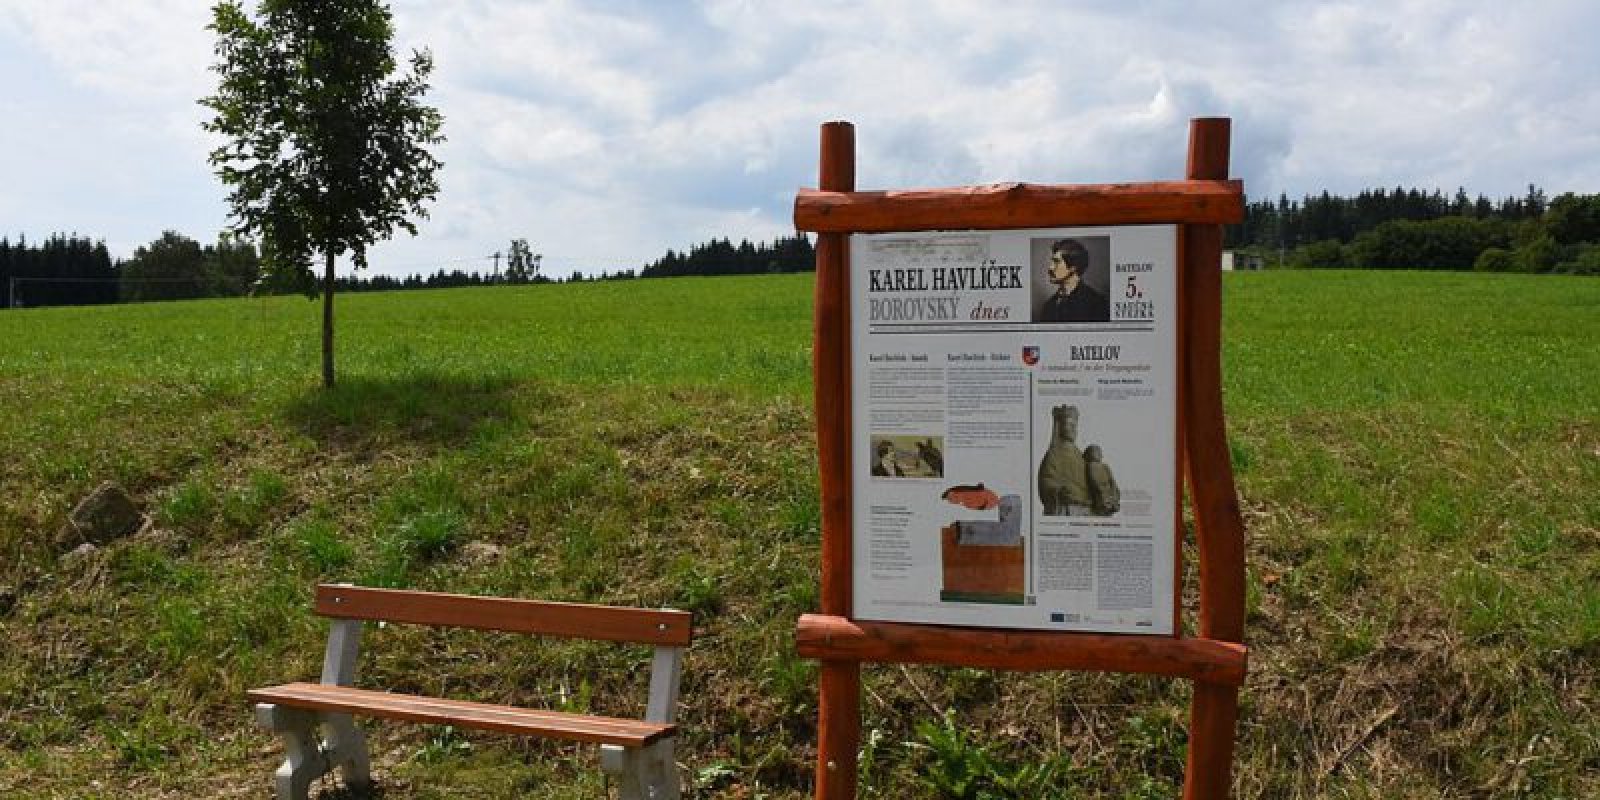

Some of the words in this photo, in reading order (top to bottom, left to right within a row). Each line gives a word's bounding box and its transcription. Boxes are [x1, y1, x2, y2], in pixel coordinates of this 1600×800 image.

[868, 269, 928, 292] KAREL
[932, 259, 1023, 291] HAVLÍČEK
[1115, 263, 1153, 272] BATELOV
[1126, 276, 1143, 298] 5.
[869, 292, 960, 320] BOROVSKÝ
[969, 300, 1010, 320] dnes
[1070, 345, 1120, 361] BATELOV
